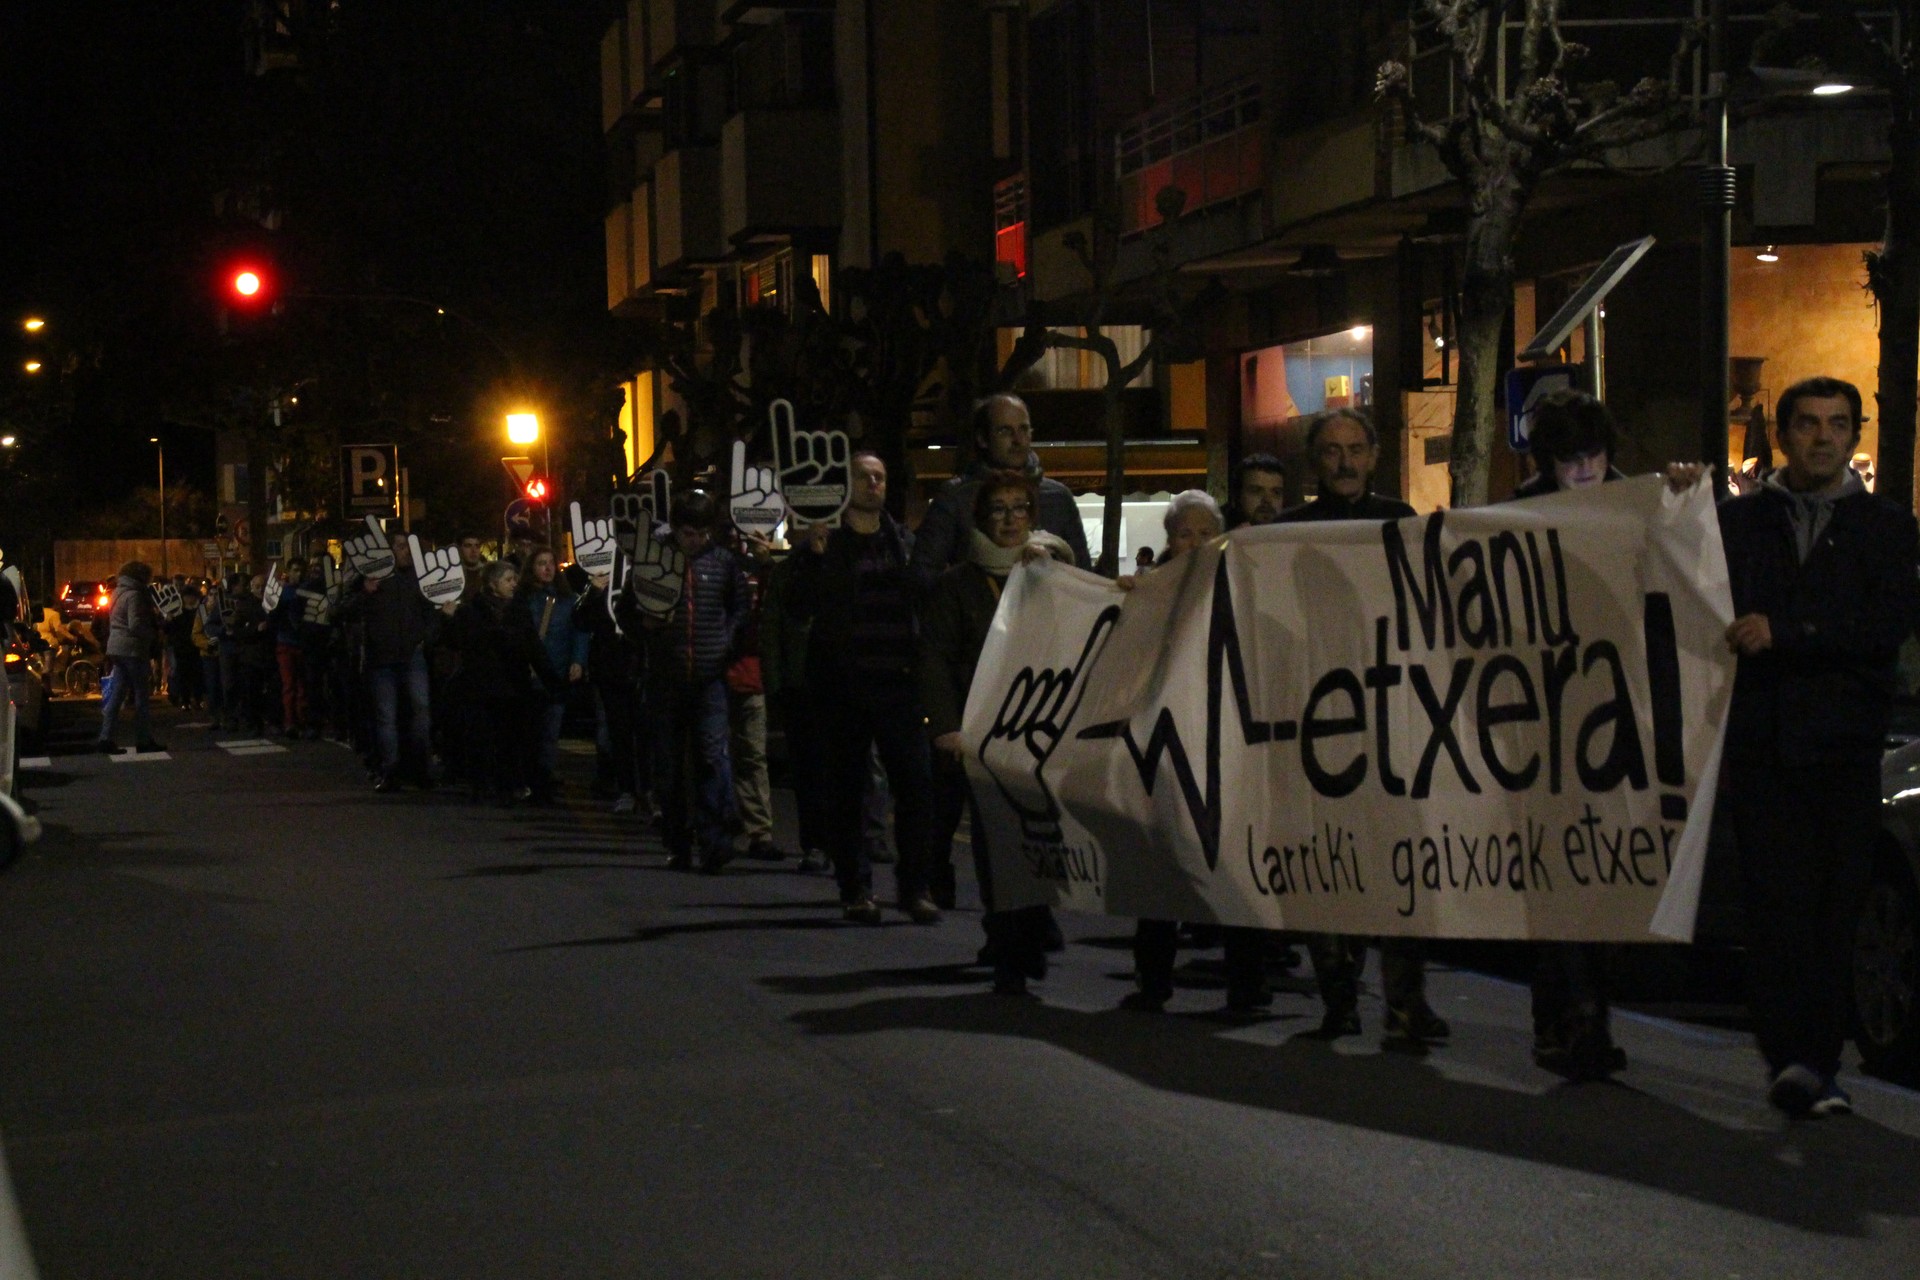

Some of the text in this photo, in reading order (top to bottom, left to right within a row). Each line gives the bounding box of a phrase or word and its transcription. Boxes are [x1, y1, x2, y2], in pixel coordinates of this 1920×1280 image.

[351, 449, 387, 495] P
[1382, 511, 1579, 650] Manu
[1301, 591, 1687, 821] etxera!
[1248, 802, 1677, 917] larriki gaixoak etxer
